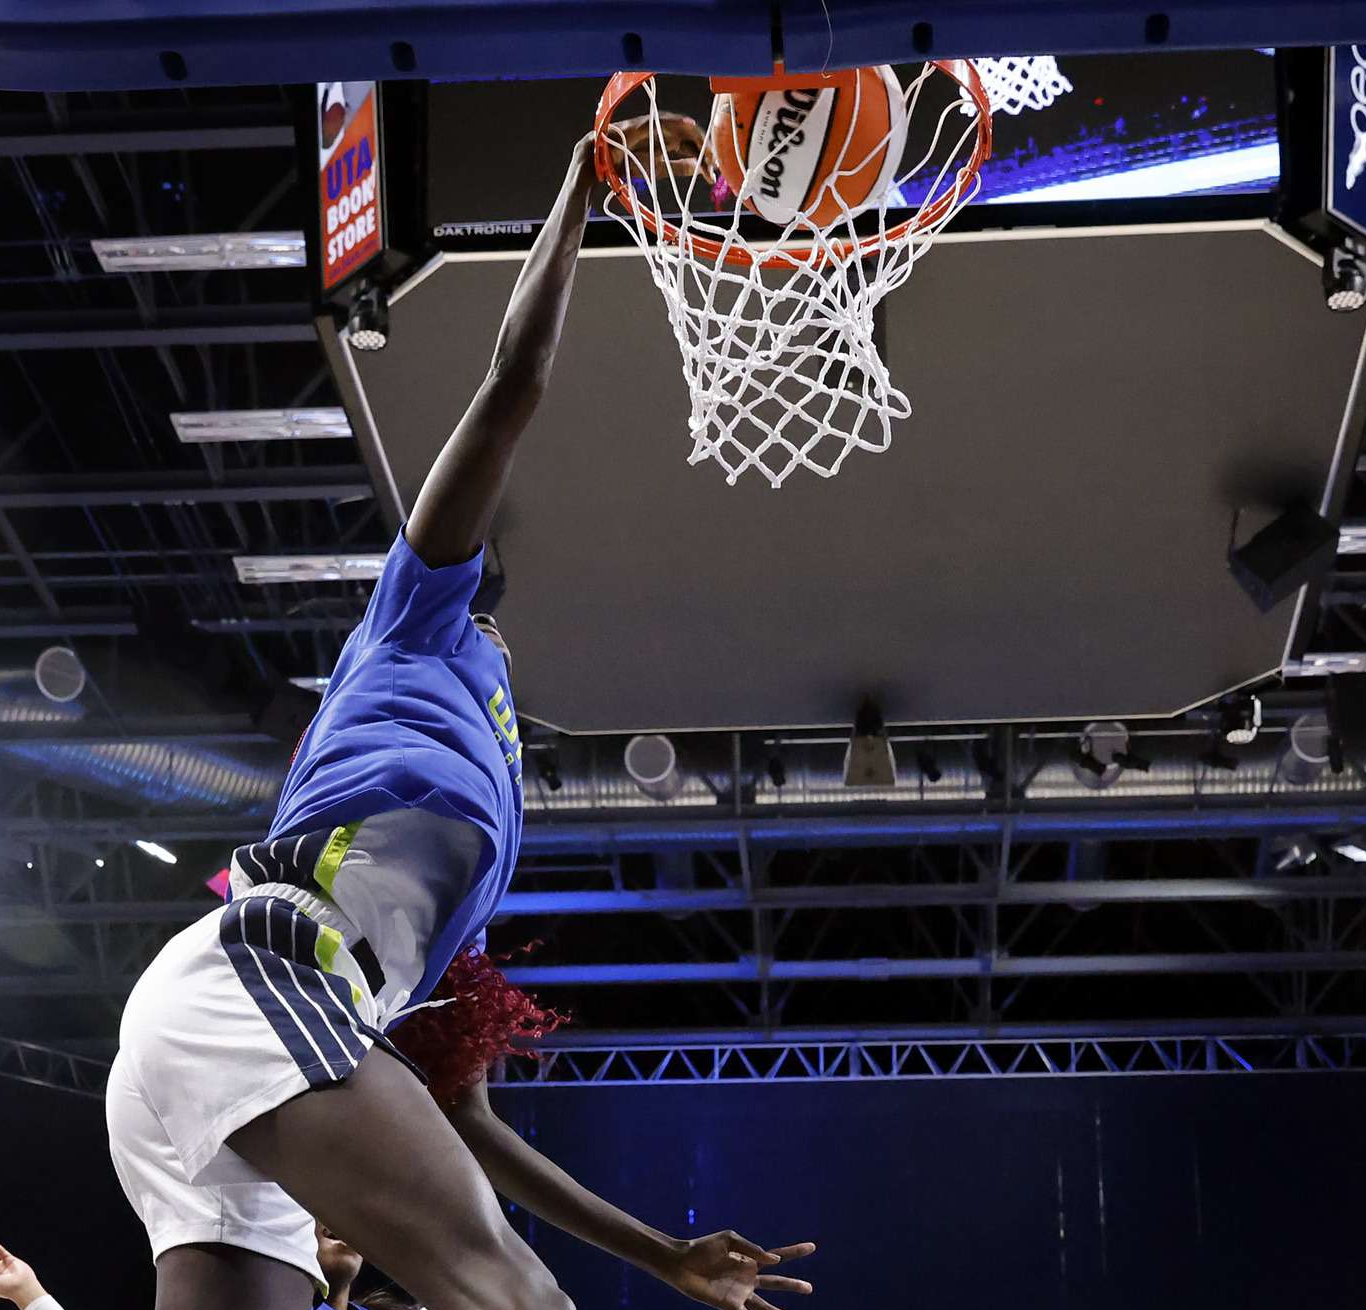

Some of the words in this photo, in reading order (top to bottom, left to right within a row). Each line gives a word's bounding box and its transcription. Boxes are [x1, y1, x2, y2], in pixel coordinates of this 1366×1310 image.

[326, 136, 373, 201] UTA
[326, 174, 375, 235] BOOK
[433, 223, 533, 238] DAKTRONICS
[327, 206, 376, 266] STORE
